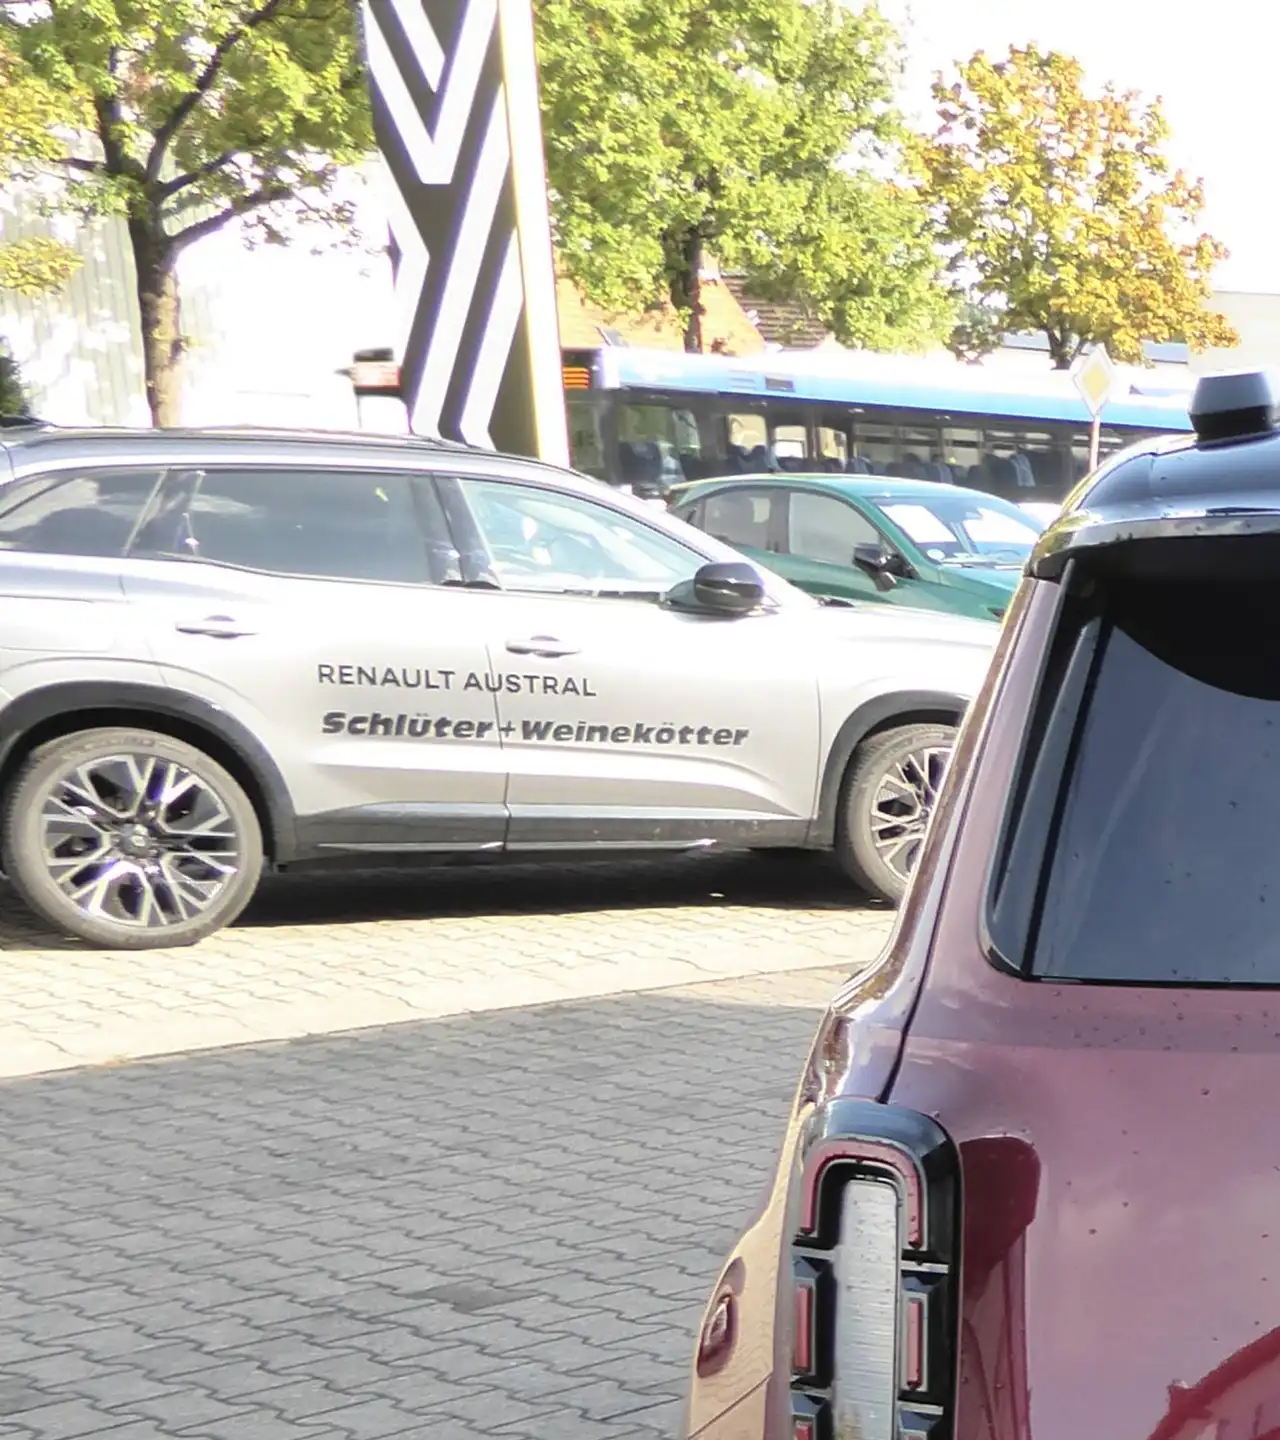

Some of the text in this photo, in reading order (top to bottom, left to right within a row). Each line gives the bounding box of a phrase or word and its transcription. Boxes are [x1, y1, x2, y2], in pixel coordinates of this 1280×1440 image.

[318, 664, 597, 697] RENAULT AUSTRAL
[322, 711, 493, 738] Schlüter
[521, 720, 749, 746] Weinekötter
